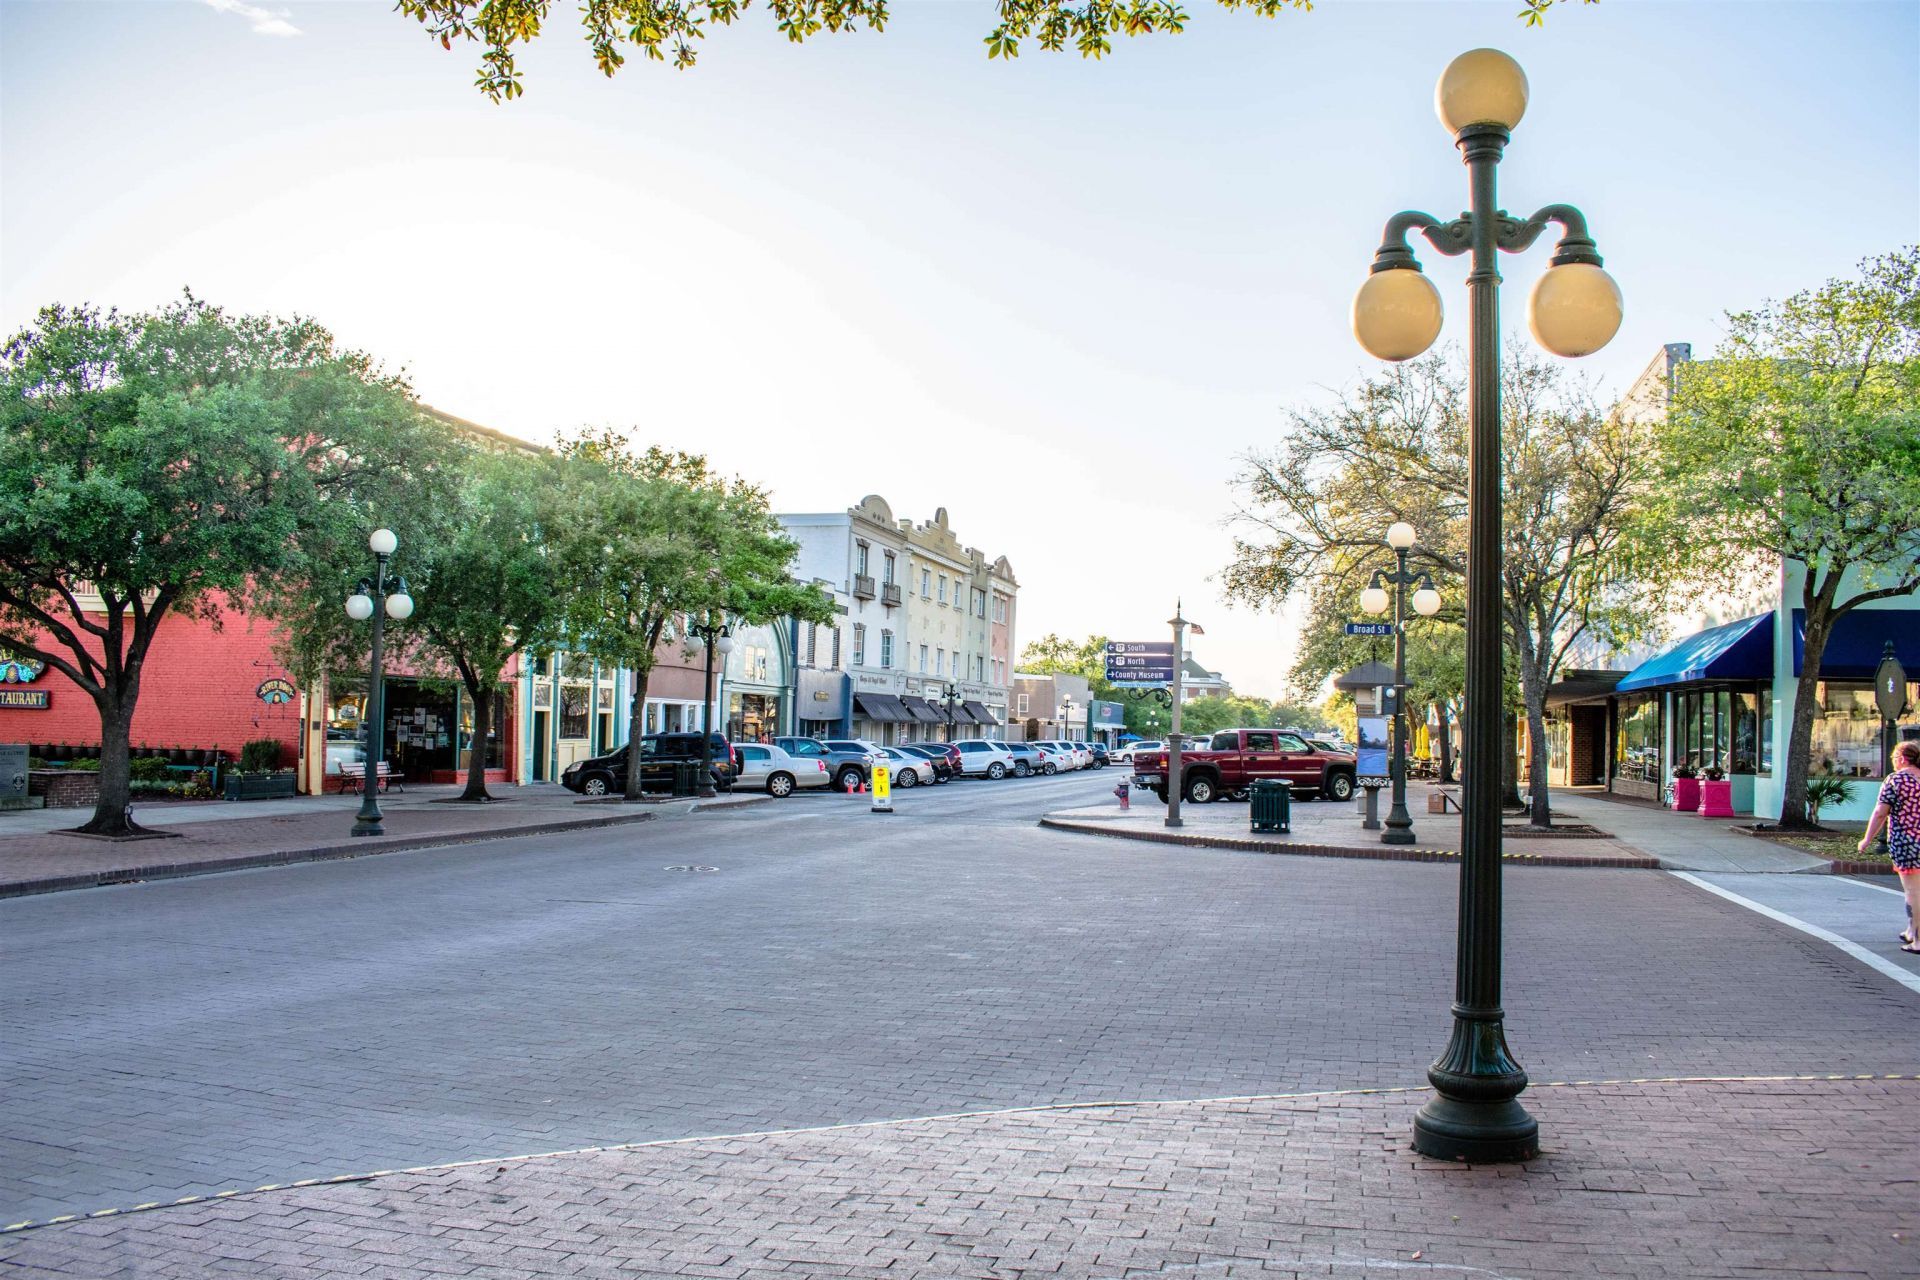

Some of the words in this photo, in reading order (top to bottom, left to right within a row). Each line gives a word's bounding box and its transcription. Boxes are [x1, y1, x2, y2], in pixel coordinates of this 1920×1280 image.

[1353, 625, 1376, 634] Broad
[1377, 625, 1385, 634] St
[1127, 644, 1146, 652] South
[1115, 671, 1137, 680] County
[1138, 671, 1164, 679] Museum
